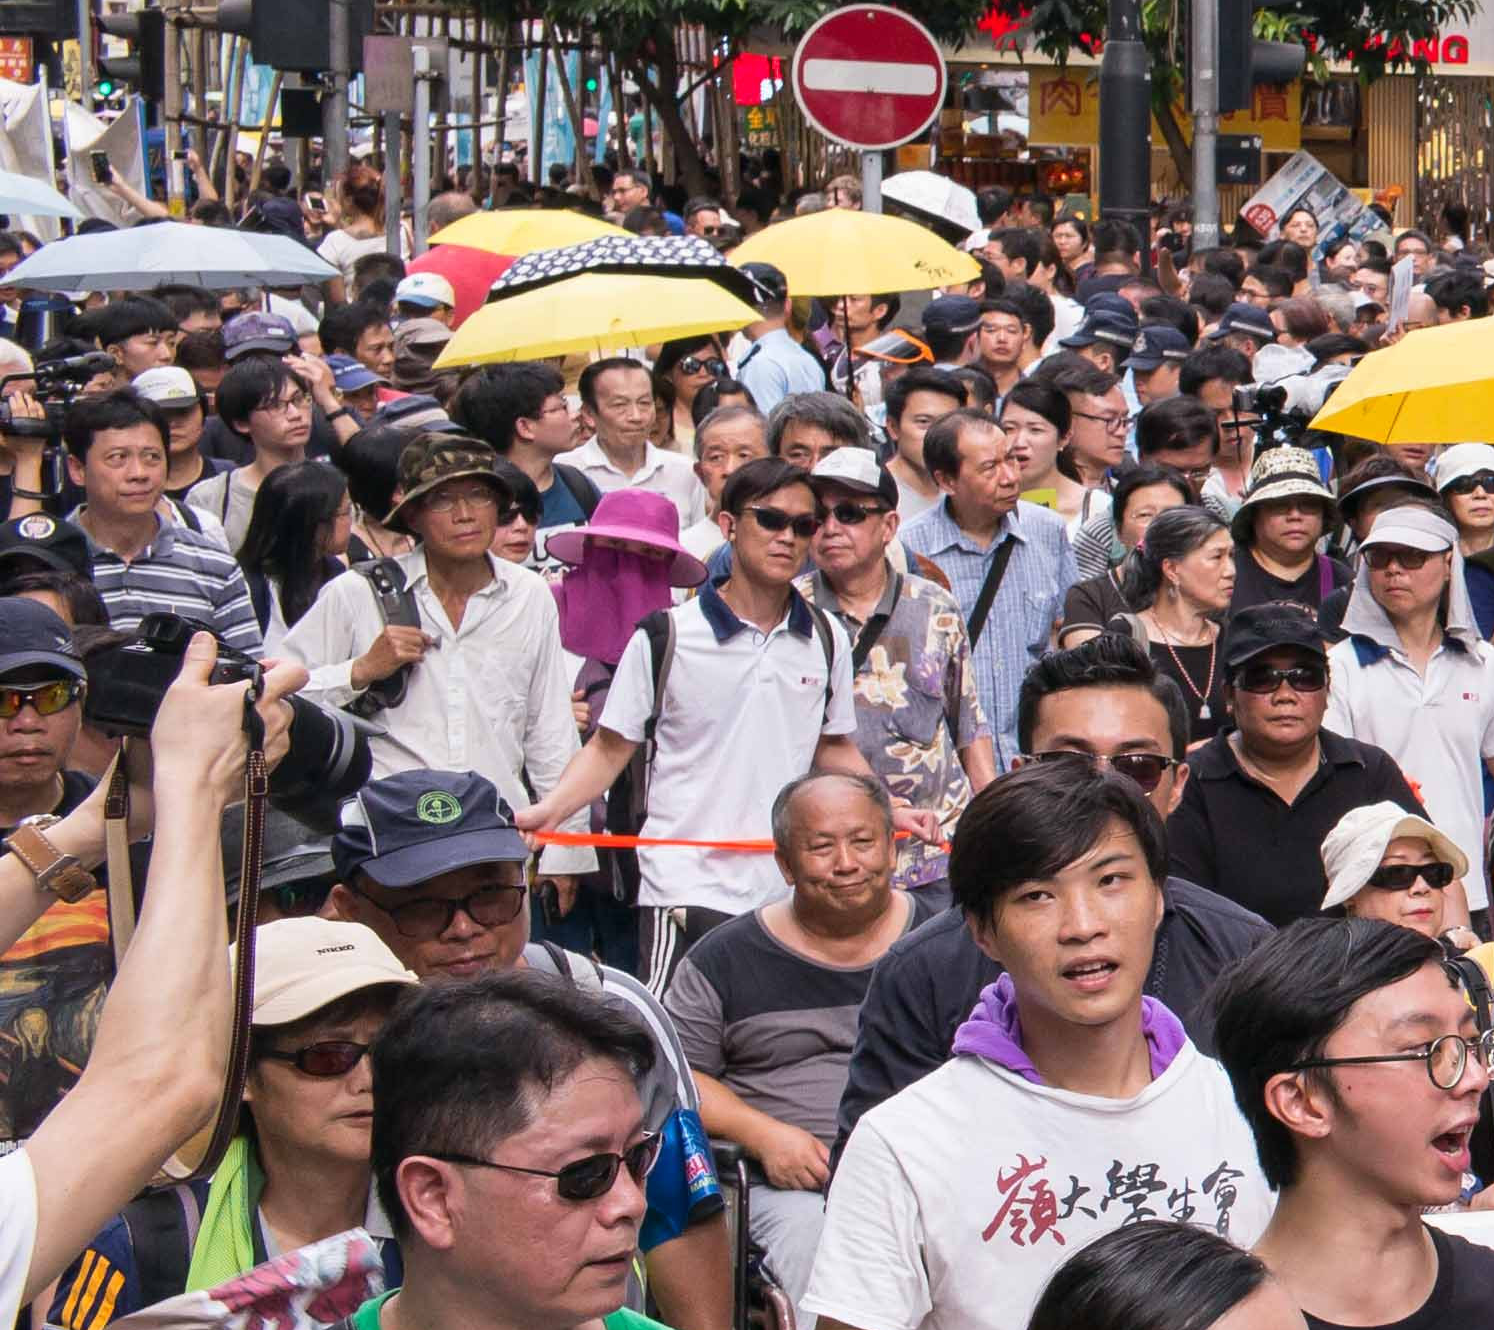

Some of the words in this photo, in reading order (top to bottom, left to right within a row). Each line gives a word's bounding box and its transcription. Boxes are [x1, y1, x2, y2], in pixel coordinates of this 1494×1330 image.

[981, 1153, 1246, 1247] 嶺大學生會
